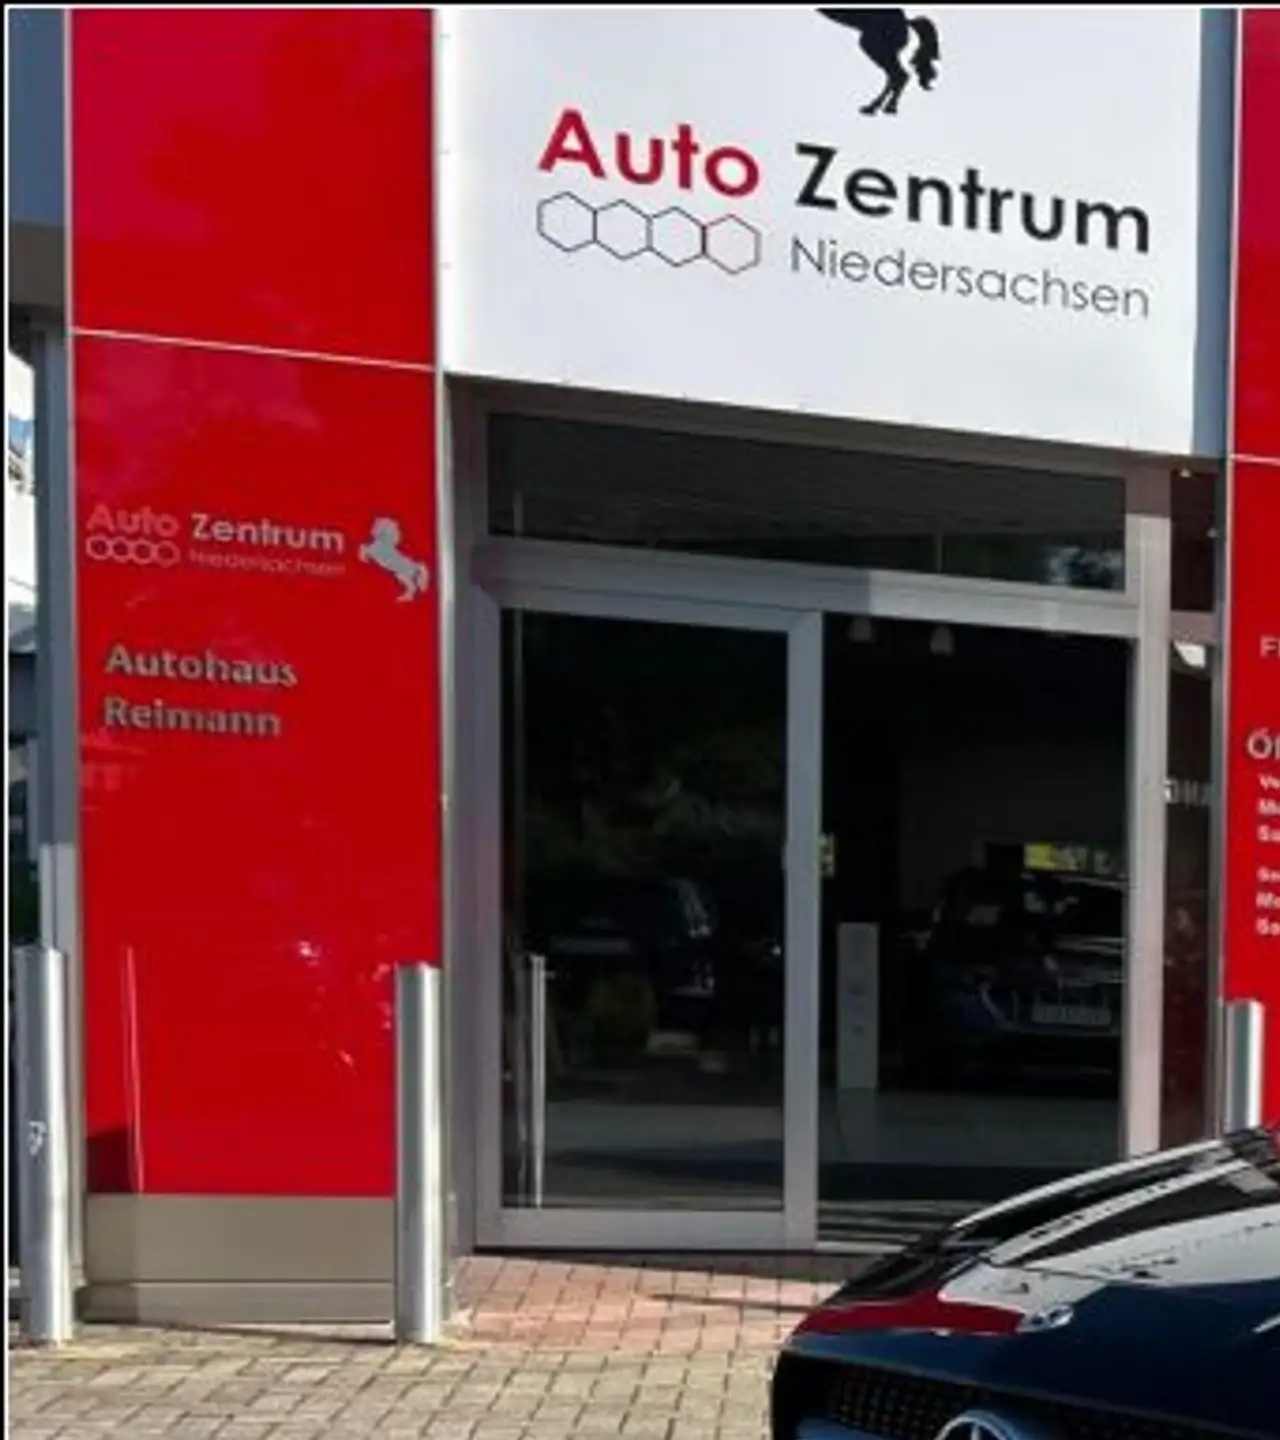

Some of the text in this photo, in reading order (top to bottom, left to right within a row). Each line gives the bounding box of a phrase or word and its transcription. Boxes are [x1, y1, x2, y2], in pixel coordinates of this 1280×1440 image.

[539, 109, 1150, 253] Auto Zentrum
[791, 237, 1149, 317] Niedersachsen
[86, 505, 345, 553] Auto Zentrum
[105, 644, 298, 687] Autohaus
[102, 697, 281, 737] Reimann
